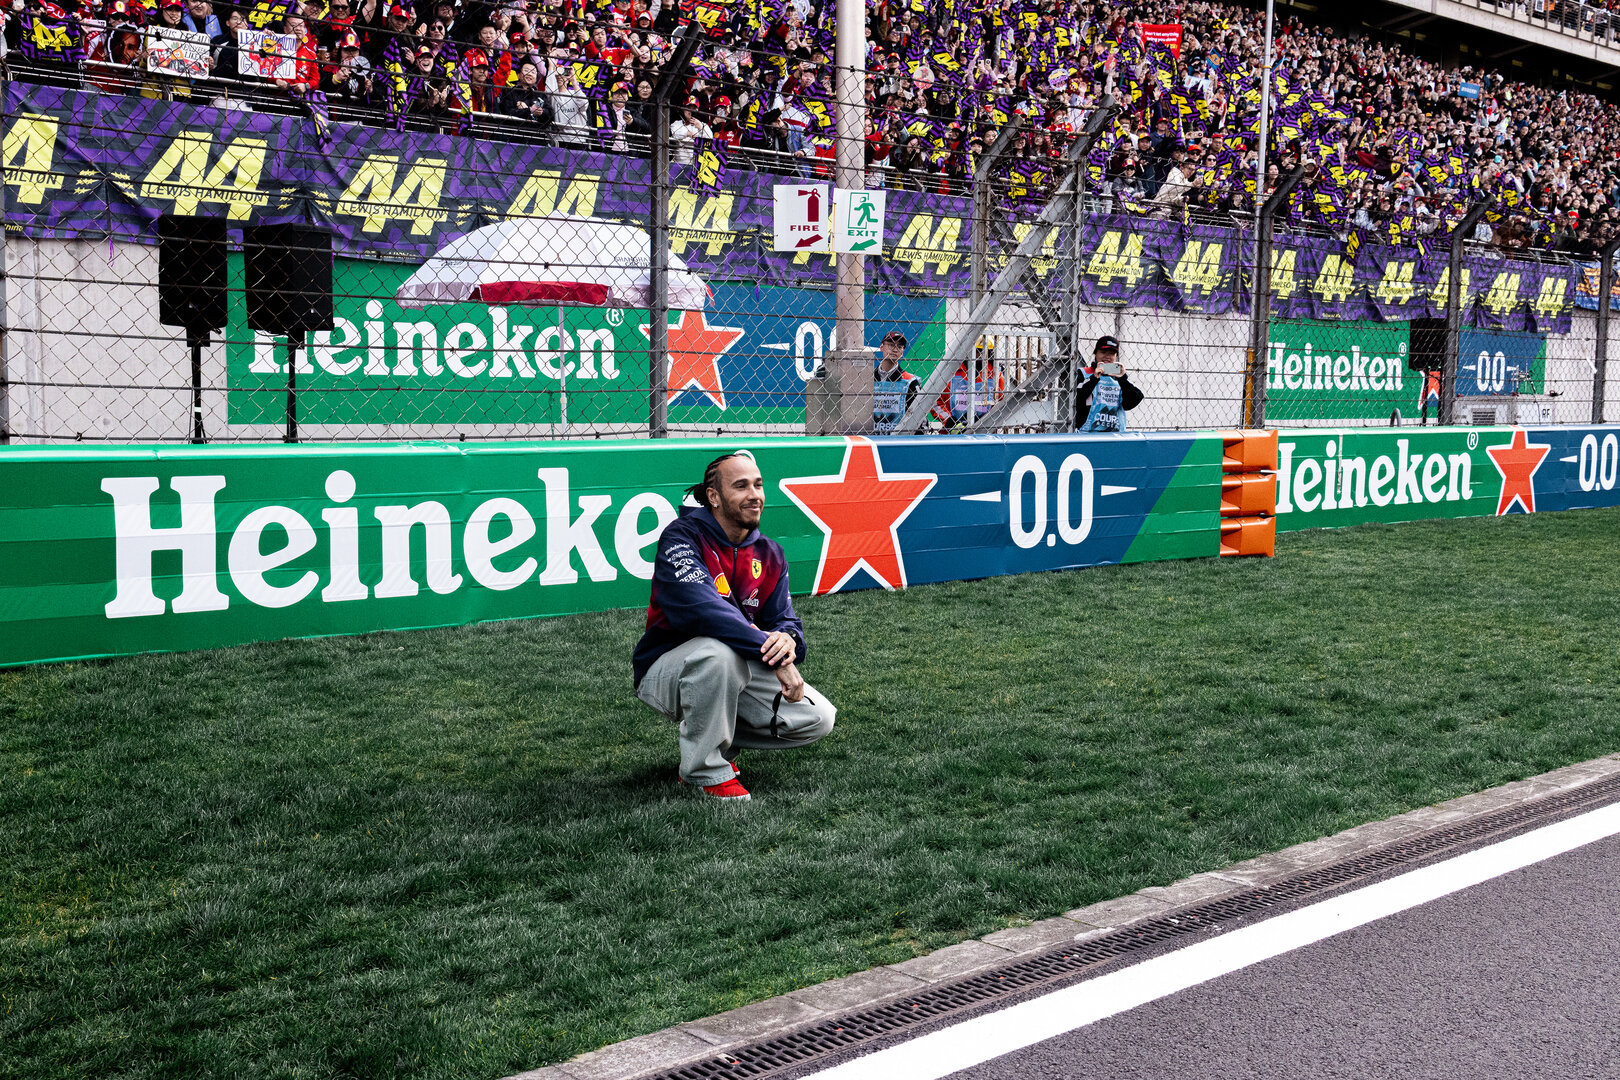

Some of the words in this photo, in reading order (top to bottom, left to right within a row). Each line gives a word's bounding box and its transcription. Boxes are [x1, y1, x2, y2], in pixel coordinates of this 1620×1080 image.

[140, 130, 269, 221] 44
[147, 185, 191, 197] LEWIS
[195, 189, 264, 202] HAMILTON
[336, 154, 449, 236] 44
[341, 202, 381, 216] LEWIS
[382, 204, 445, 219] HAMILTON
[848, 229, 878, 237] EXIT
[668, 229, 684, 239] WIS
[685, 230, 732, 241] HAMILTON
[892, 212, 962, 275] 44
[896, 251, 922, 260] LEWIS
[923, 252, 958, 262] HAMILTON
[1086, 231, 1144, 287] 44
[1089, 266, 1109, 274] LEWIS
[1110, 267, 1141, 275] HAMILTON
[1173, 240, 1223, 295] 44
[1313, 255, 1355, 303] 44
[1477, 351, 1505, 392] 0.0
[873, 422, 896, 431] URSE
[1579, 433, 1618, 492] 0.0
[1009, 453, 1094, 549] 0.0
[101, 467, 690, 619] Heineke
